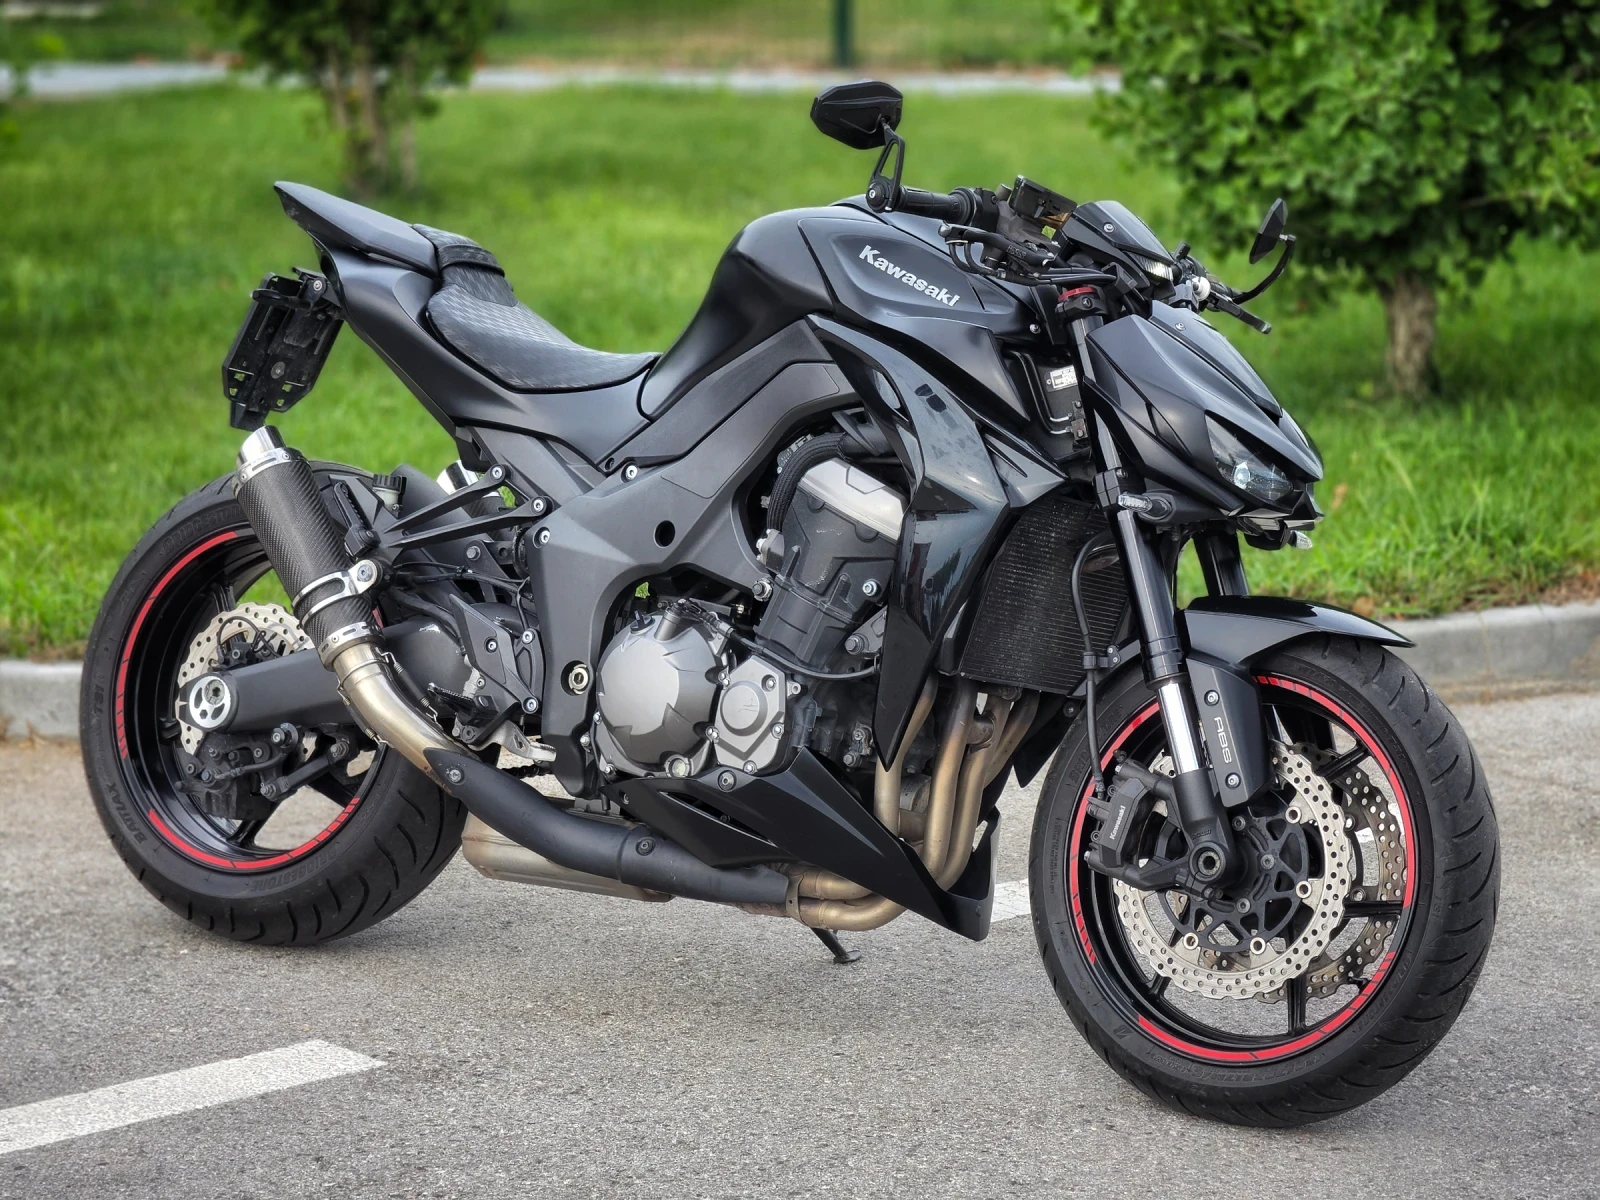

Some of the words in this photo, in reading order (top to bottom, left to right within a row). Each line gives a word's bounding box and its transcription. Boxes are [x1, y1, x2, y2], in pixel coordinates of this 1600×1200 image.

[859, 245, 960, 307] Kawasaki
[1214, 716, 1232, 764] ABS
[107, 781, 148, 845] BATTLAX
[1110, 805, 1126, 840] Kawasaki
[250, 843, 340, 892] BRIDGESTONE
